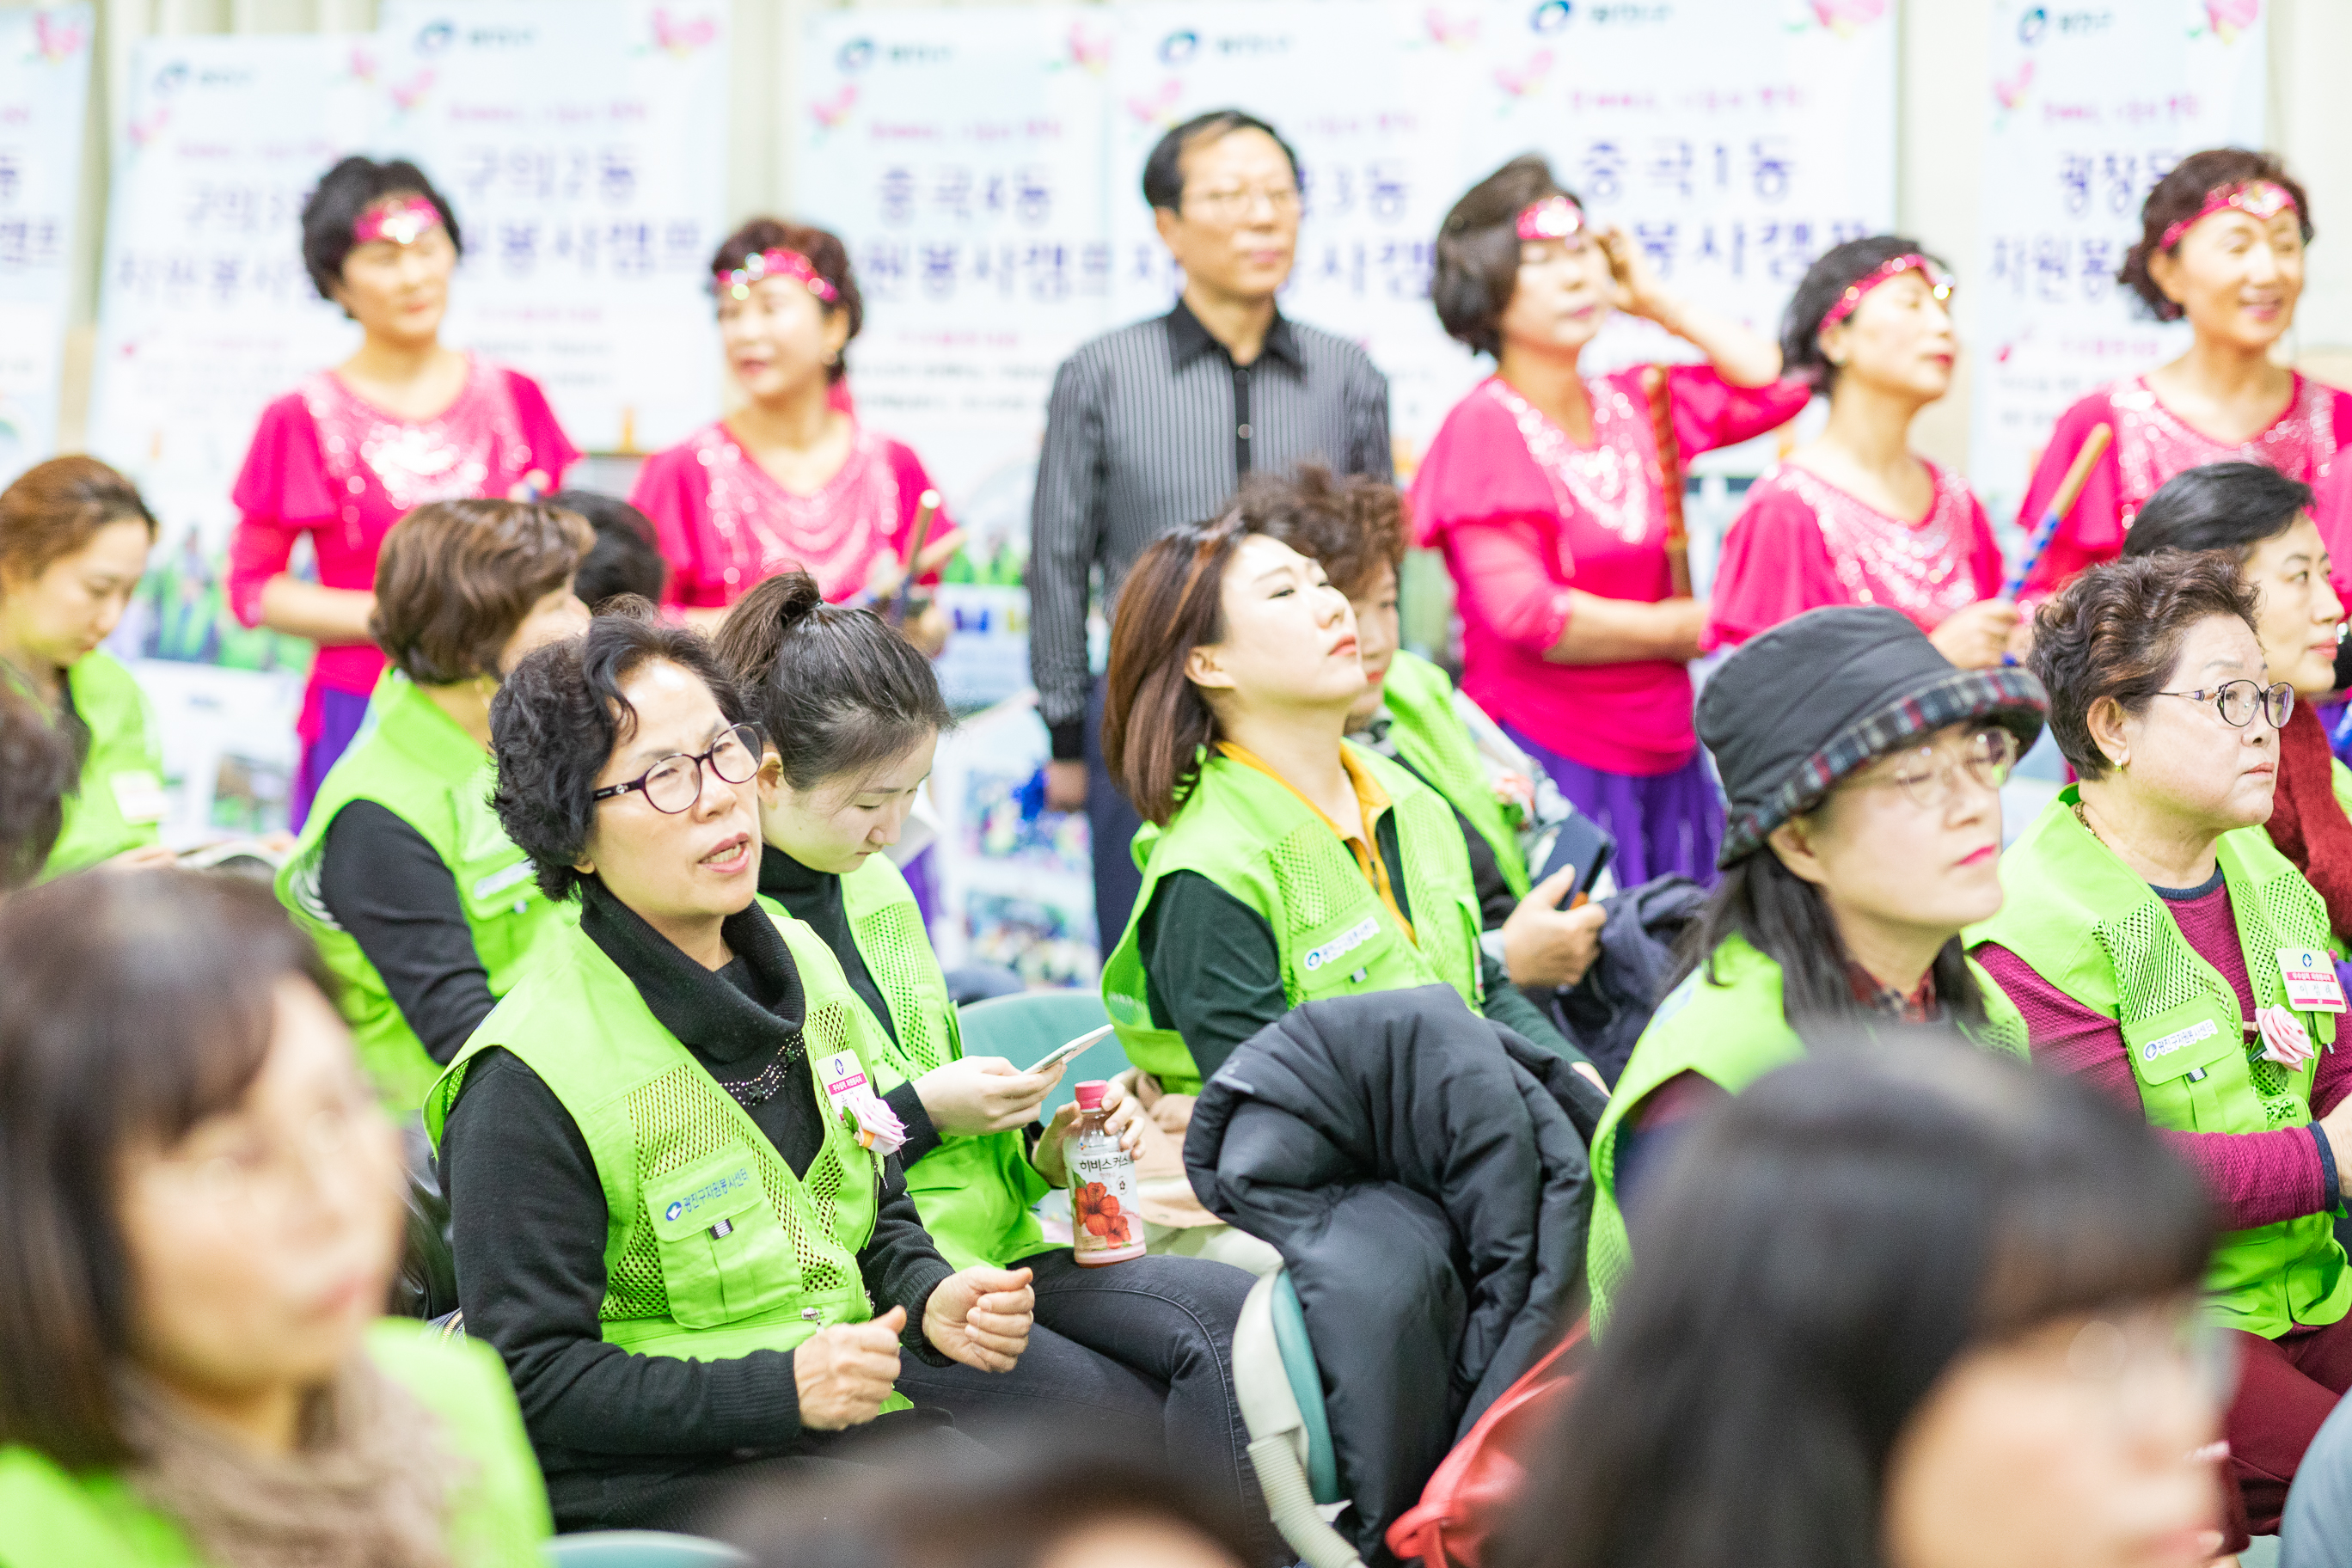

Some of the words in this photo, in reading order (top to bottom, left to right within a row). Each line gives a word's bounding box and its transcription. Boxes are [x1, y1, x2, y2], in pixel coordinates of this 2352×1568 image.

[2157, 1020, 2217, 1054] 광진구자원봉사센터
[1080, 1155, 1131, 1173] 히비스커스
[683, 1167, 750, 1213] 광진구자원봉사센터
